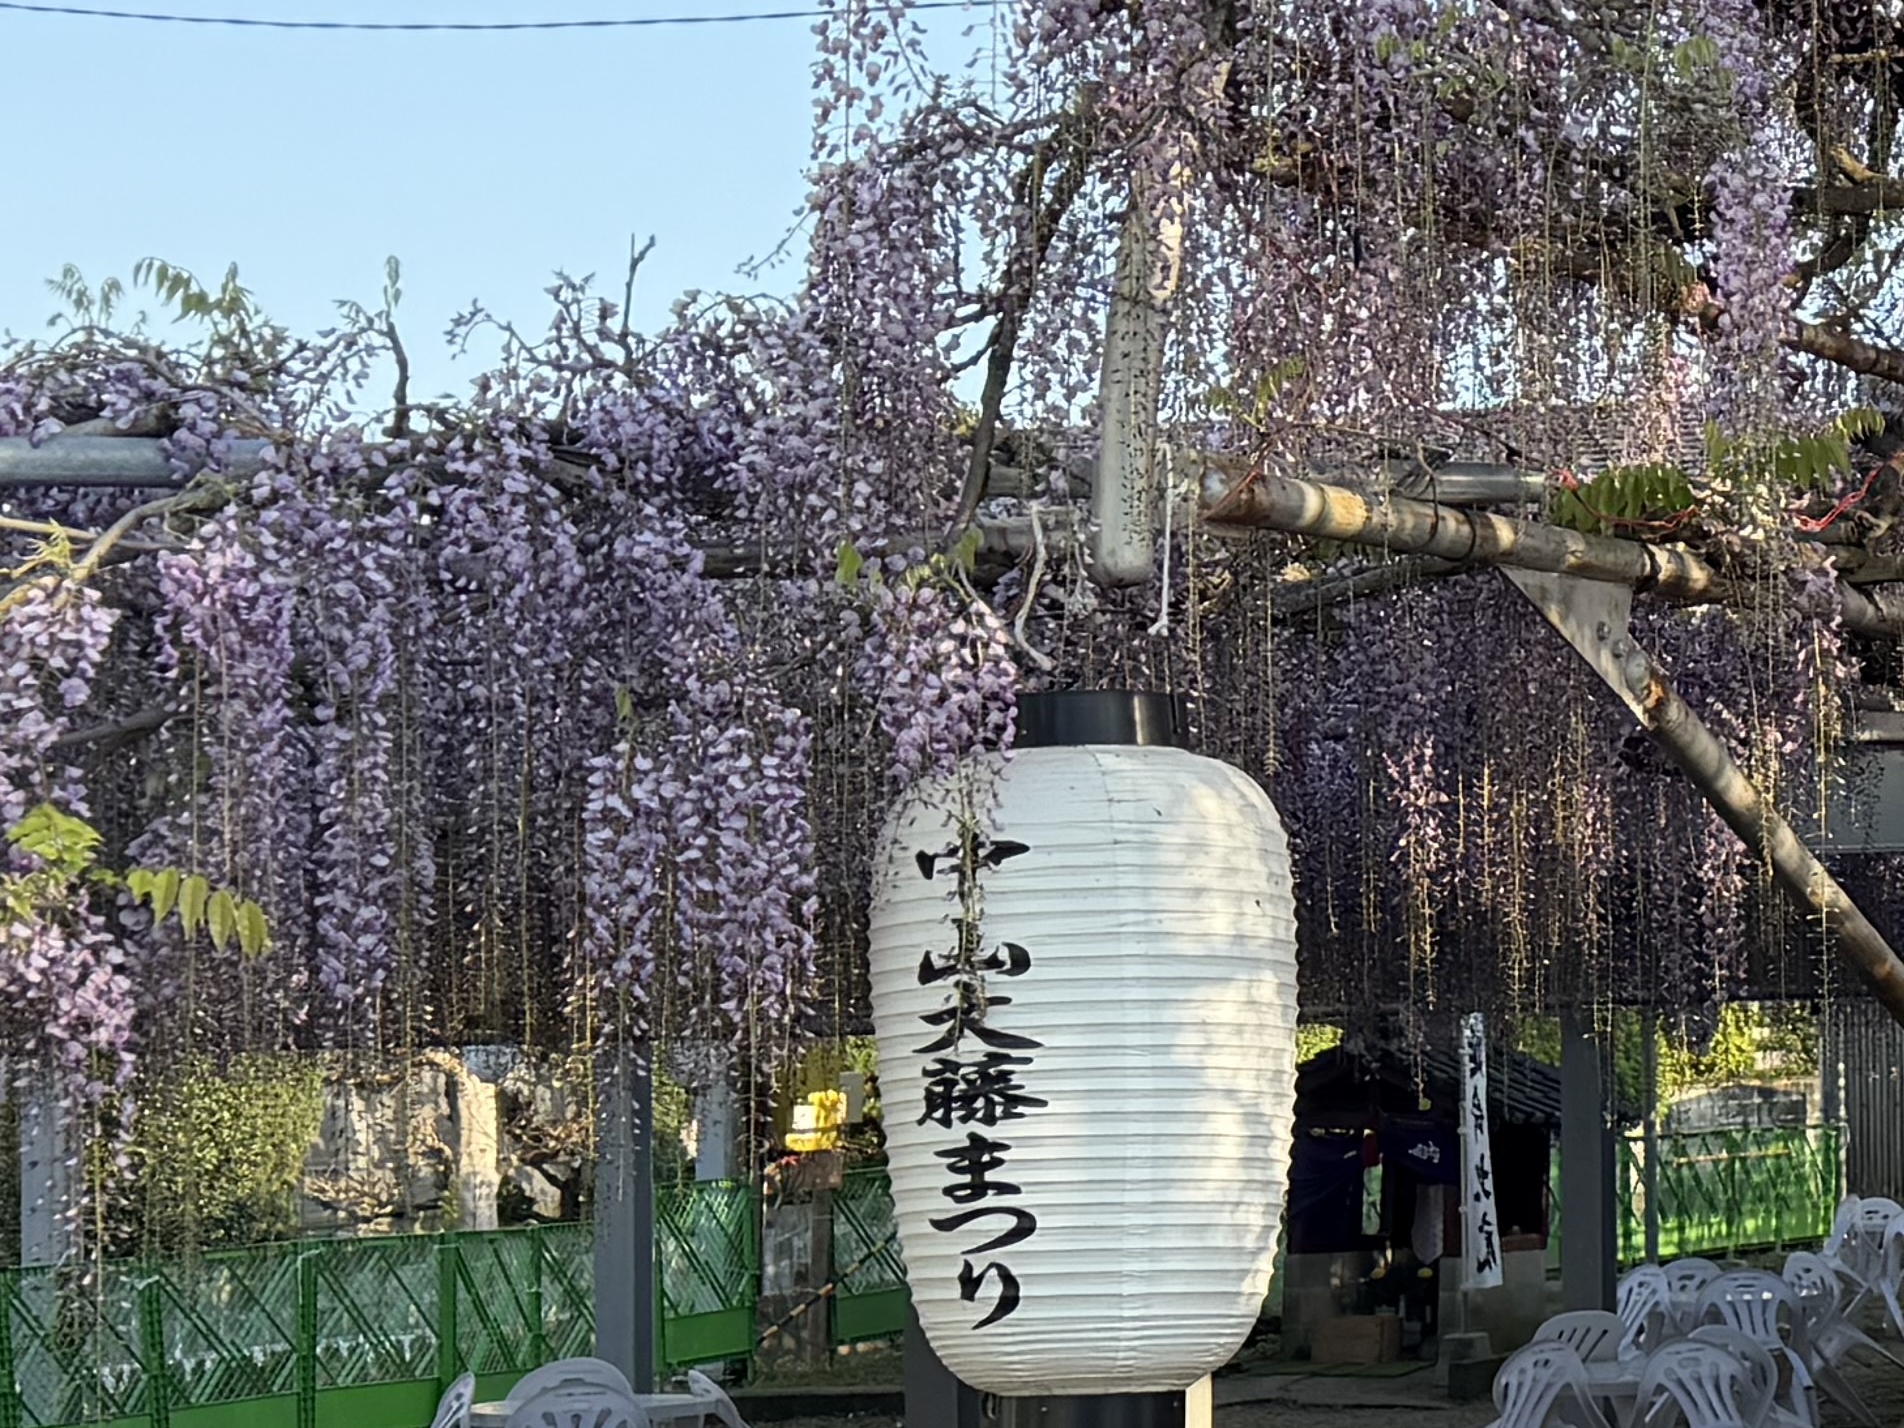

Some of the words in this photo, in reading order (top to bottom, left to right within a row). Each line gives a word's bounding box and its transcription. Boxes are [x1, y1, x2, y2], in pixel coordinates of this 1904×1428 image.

[912, 818, 1048, 1331] 中山大藤まつり
